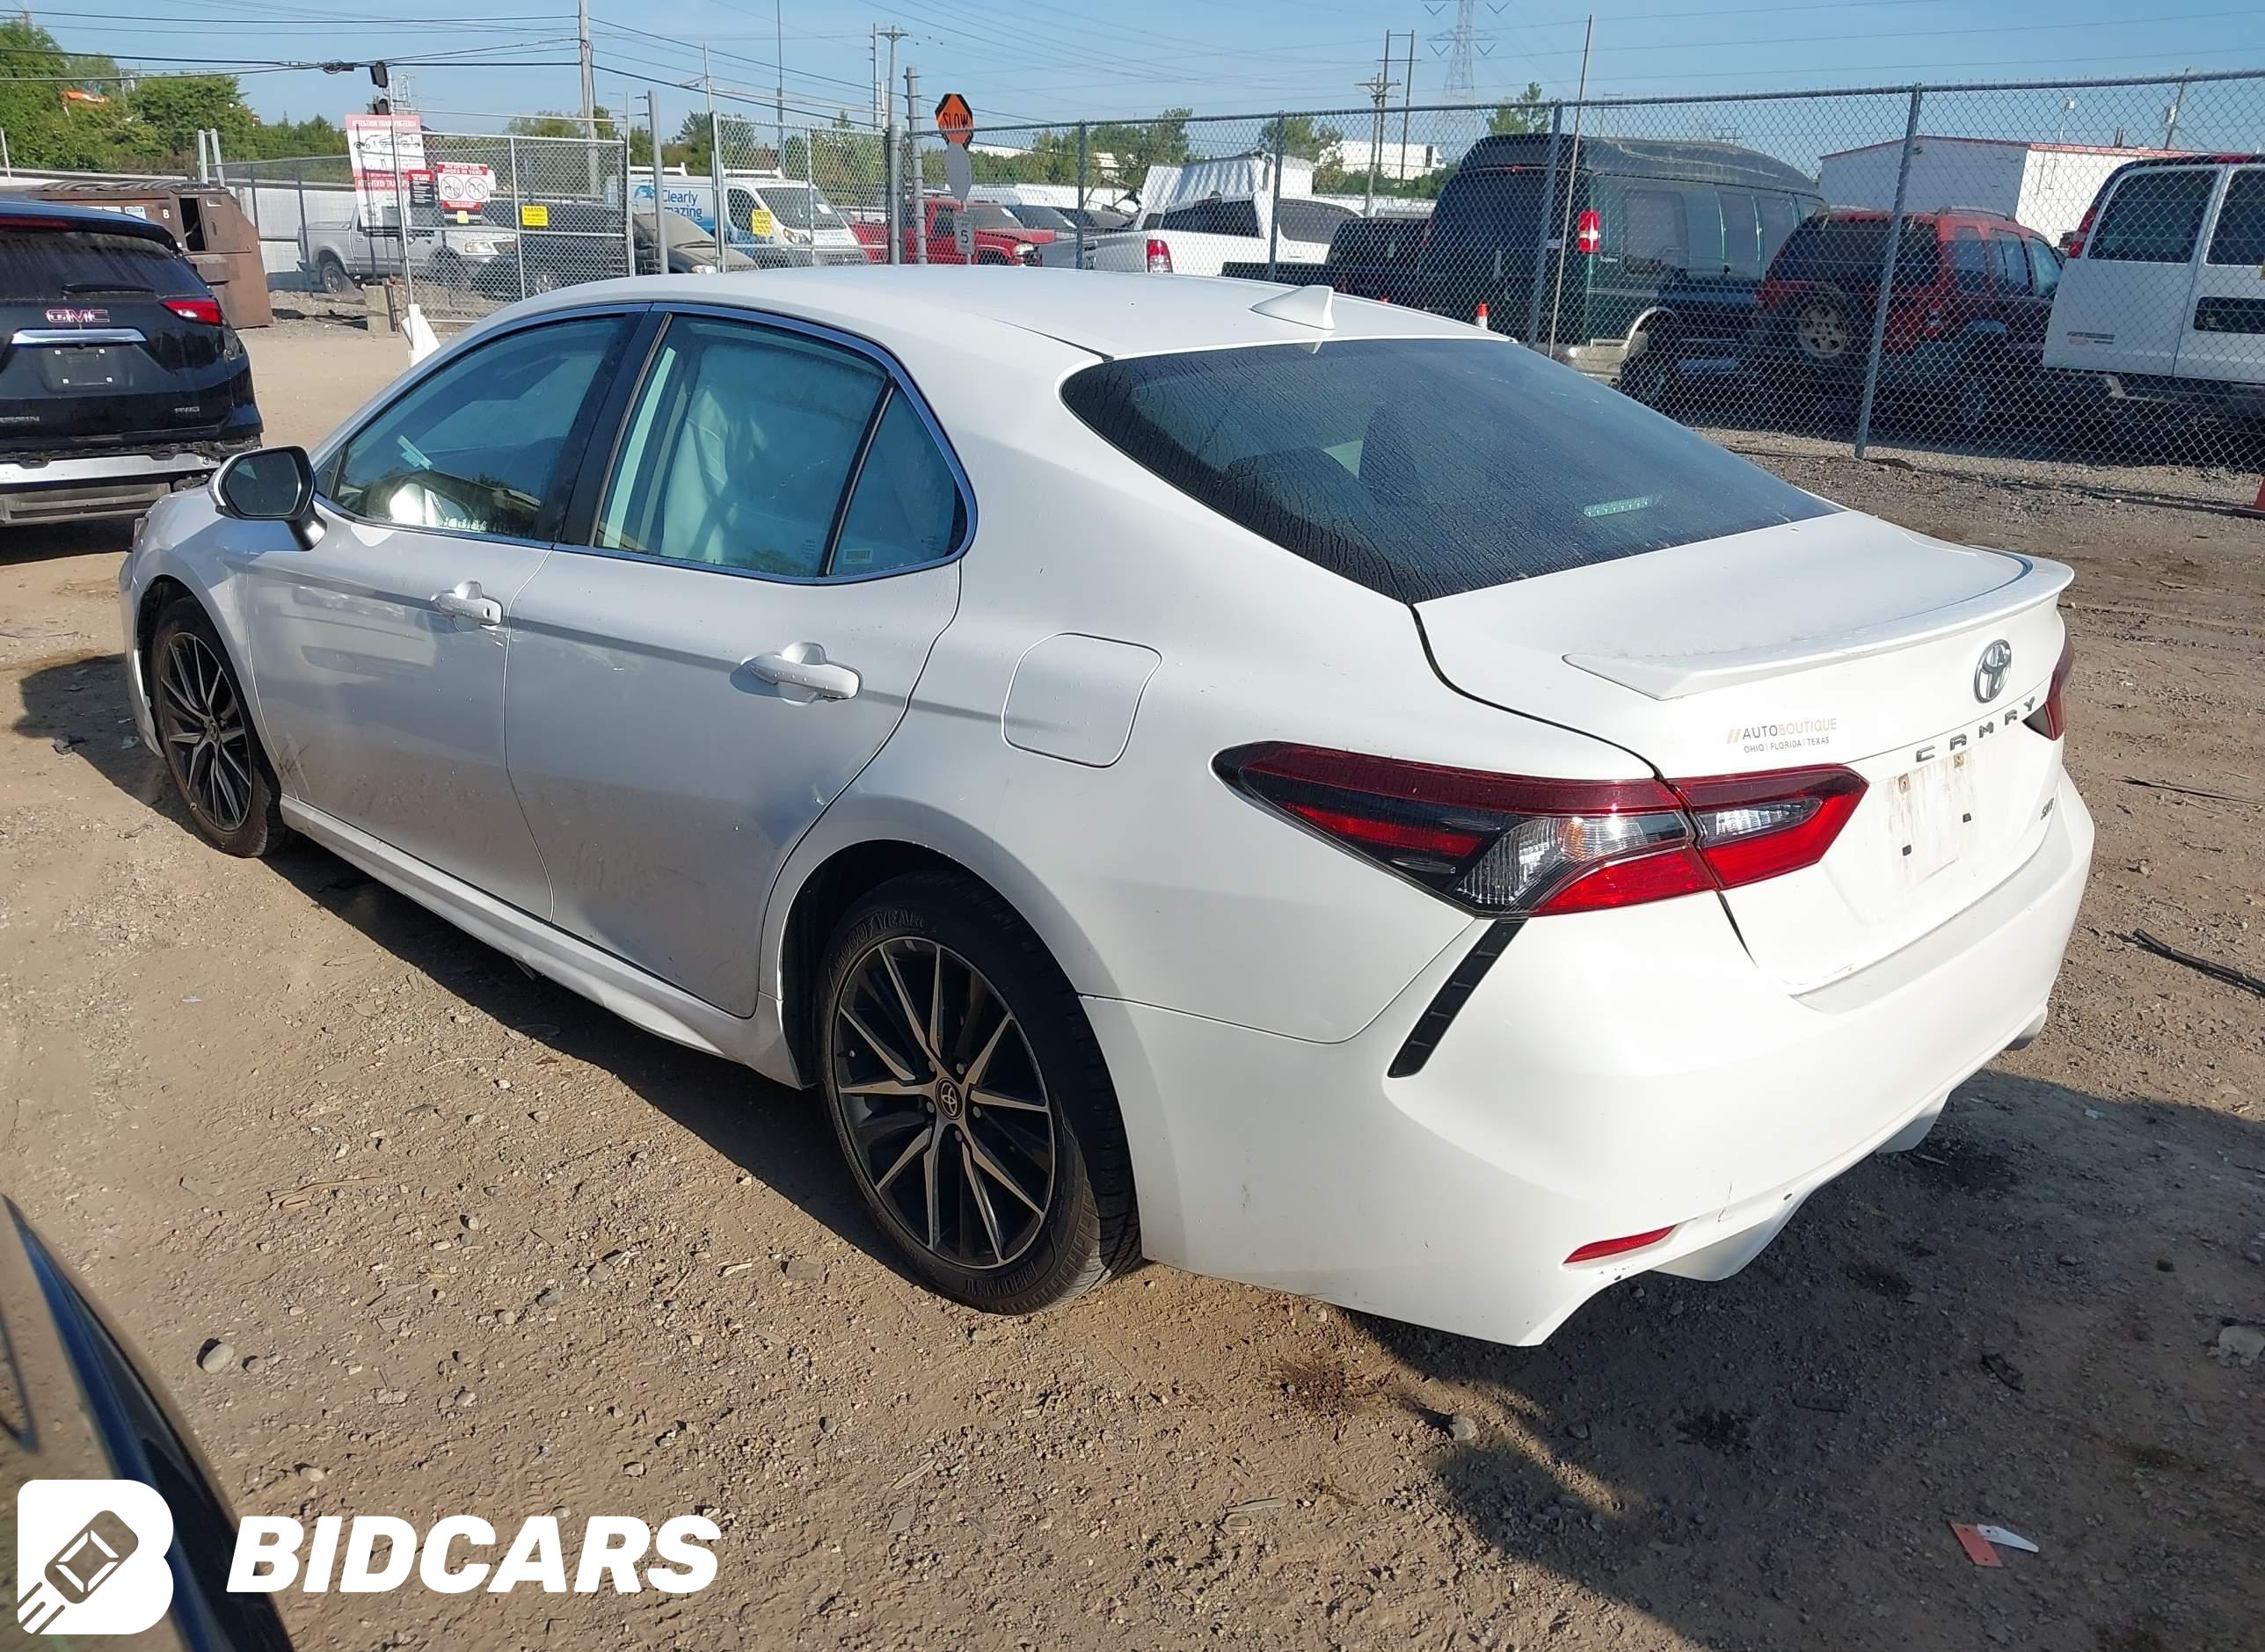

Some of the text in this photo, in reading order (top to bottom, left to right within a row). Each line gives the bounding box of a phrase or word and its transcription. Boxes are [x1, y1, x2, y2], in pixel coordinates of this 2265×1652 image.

[943, 112, 969, 129] SLOW
[162, 208, 170, 219] 8
[960, 229, 969, 244] 5
[46, 309, 110, 323] GMC
[1742, 717, 1837, 740] AUTOBOUTIQUE
[1915, 695, 2036, 763] CAMRY
[1770, 739, 1803, 751] FLORIDA
[1807, 736, 1830, 747] TEXAS
